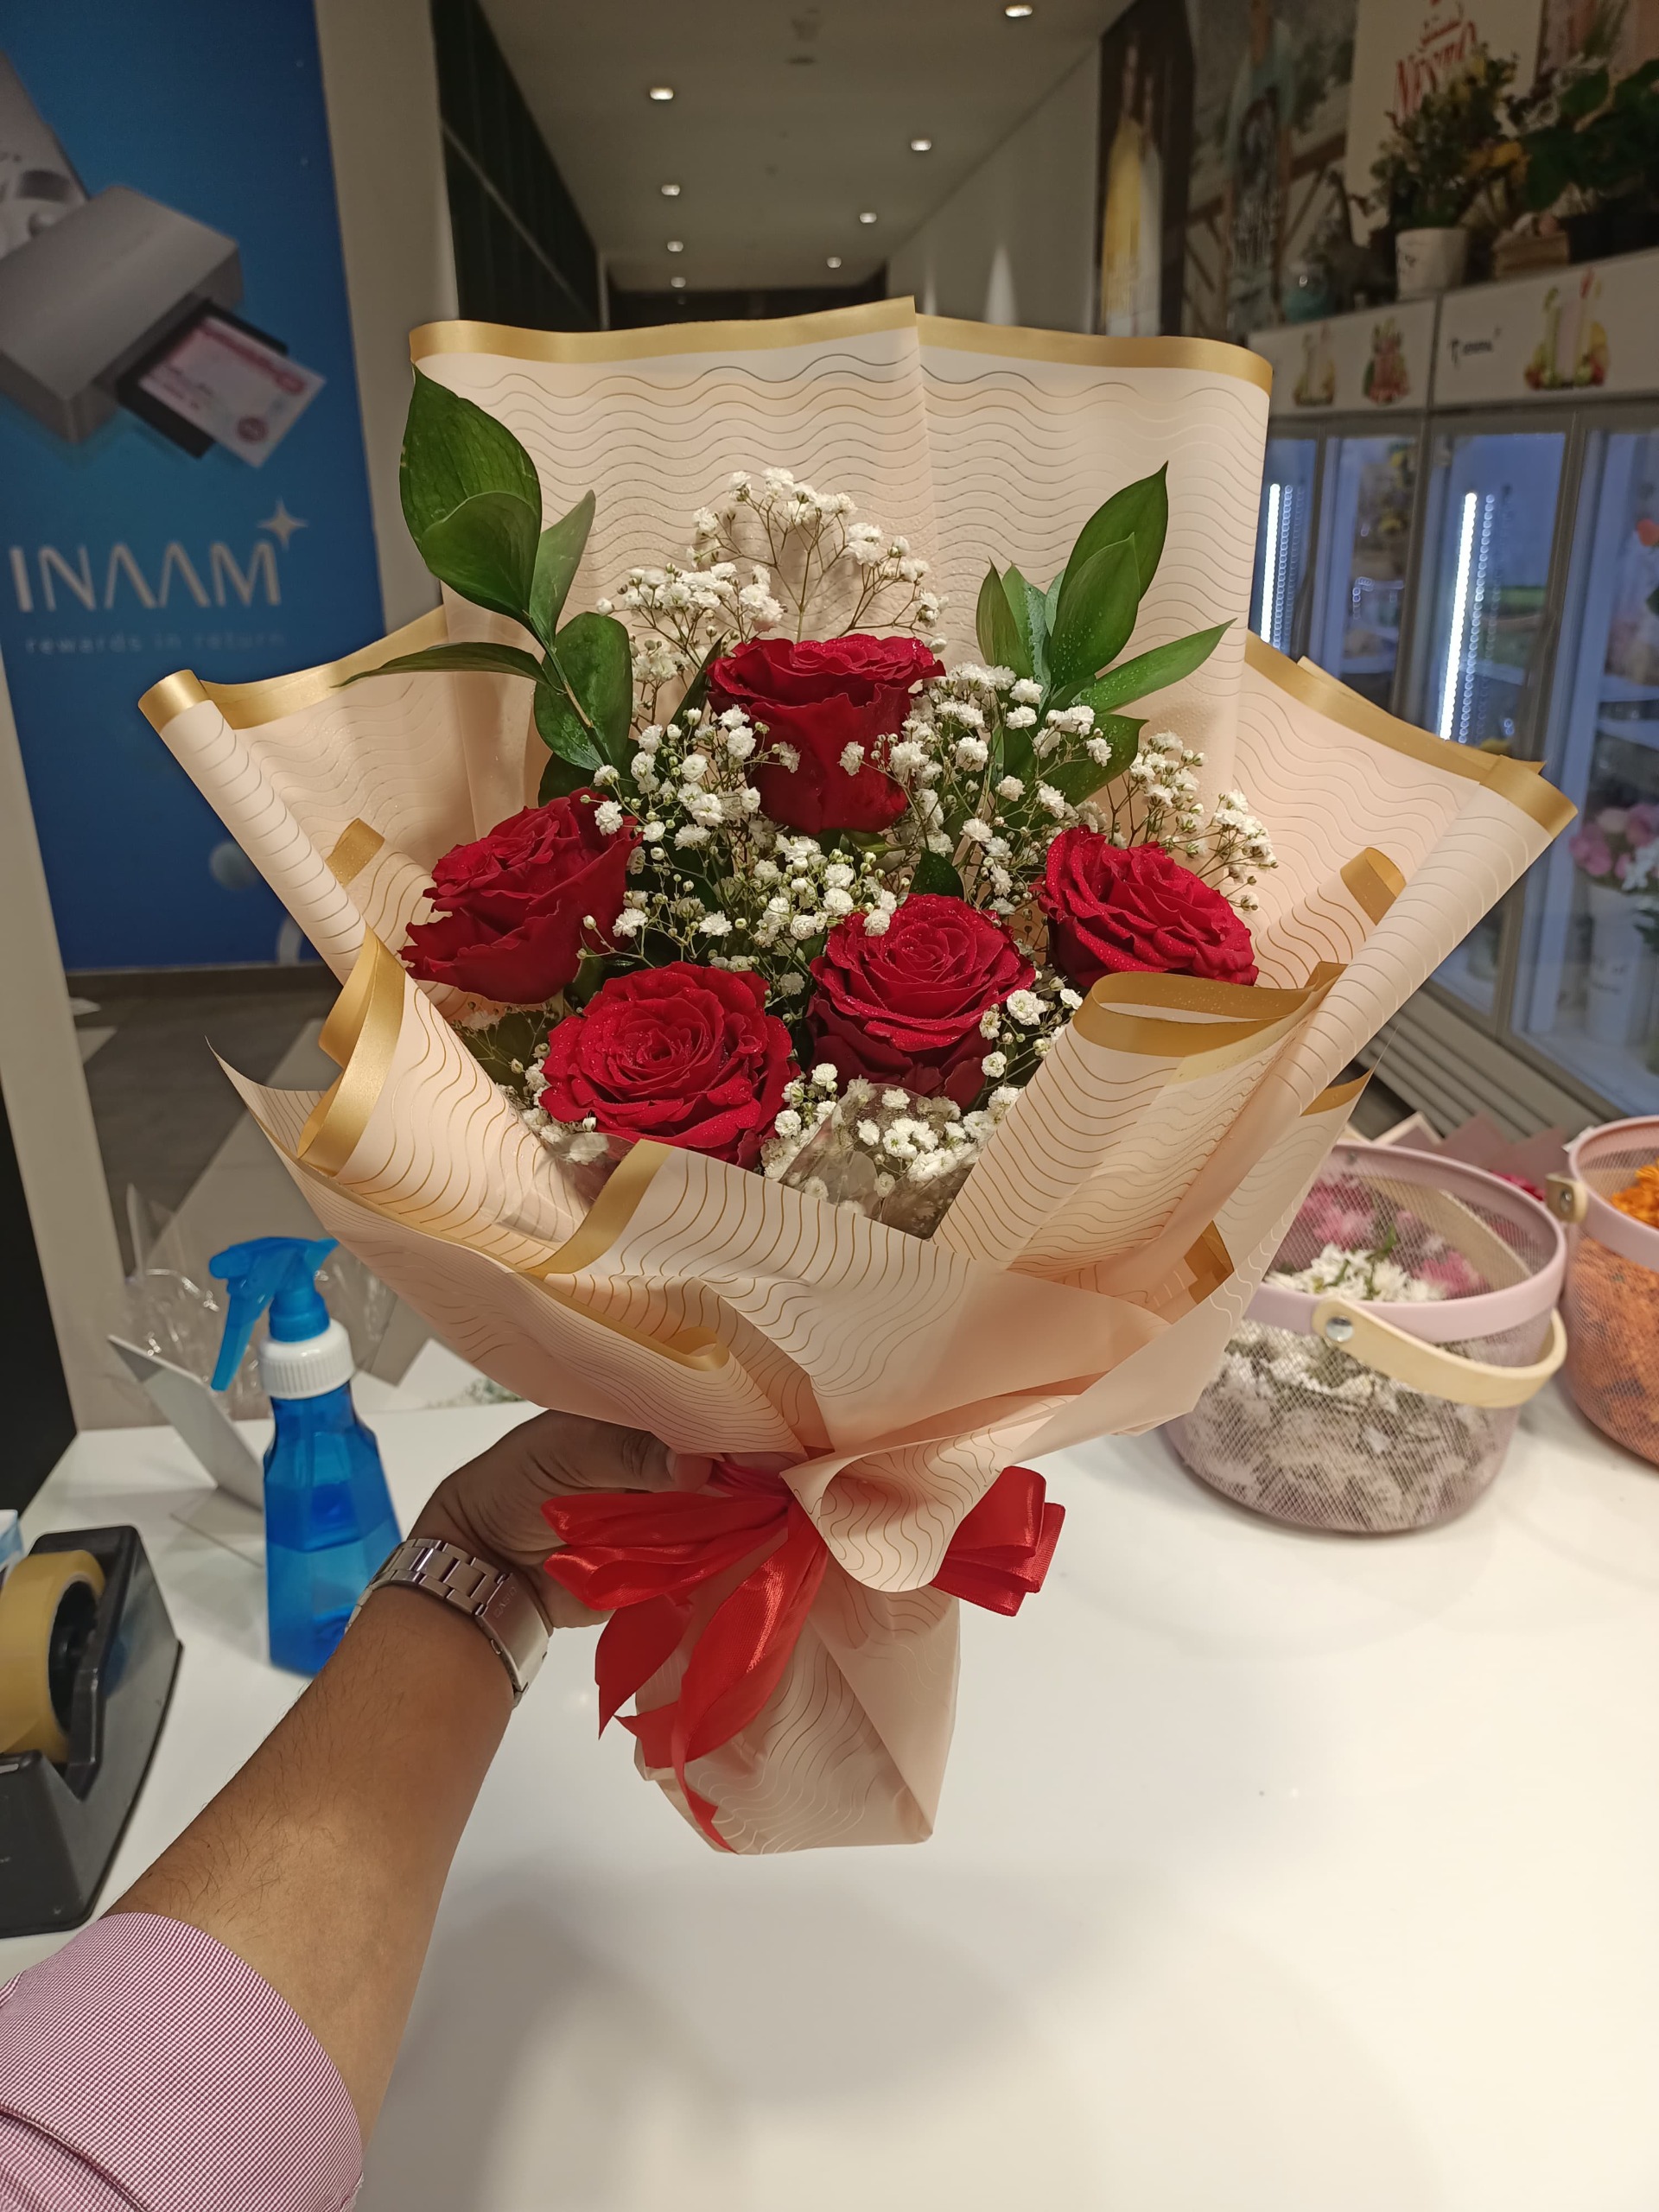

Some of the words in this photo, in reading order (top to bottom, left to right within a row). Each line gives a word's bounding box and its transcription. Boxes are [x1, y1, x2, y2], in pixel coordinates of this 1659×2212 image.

[10, 542, 282, 612] INAAM
[25, 632, 143, 654] rewards
[493, 1586, 517, 1618] CASIO
